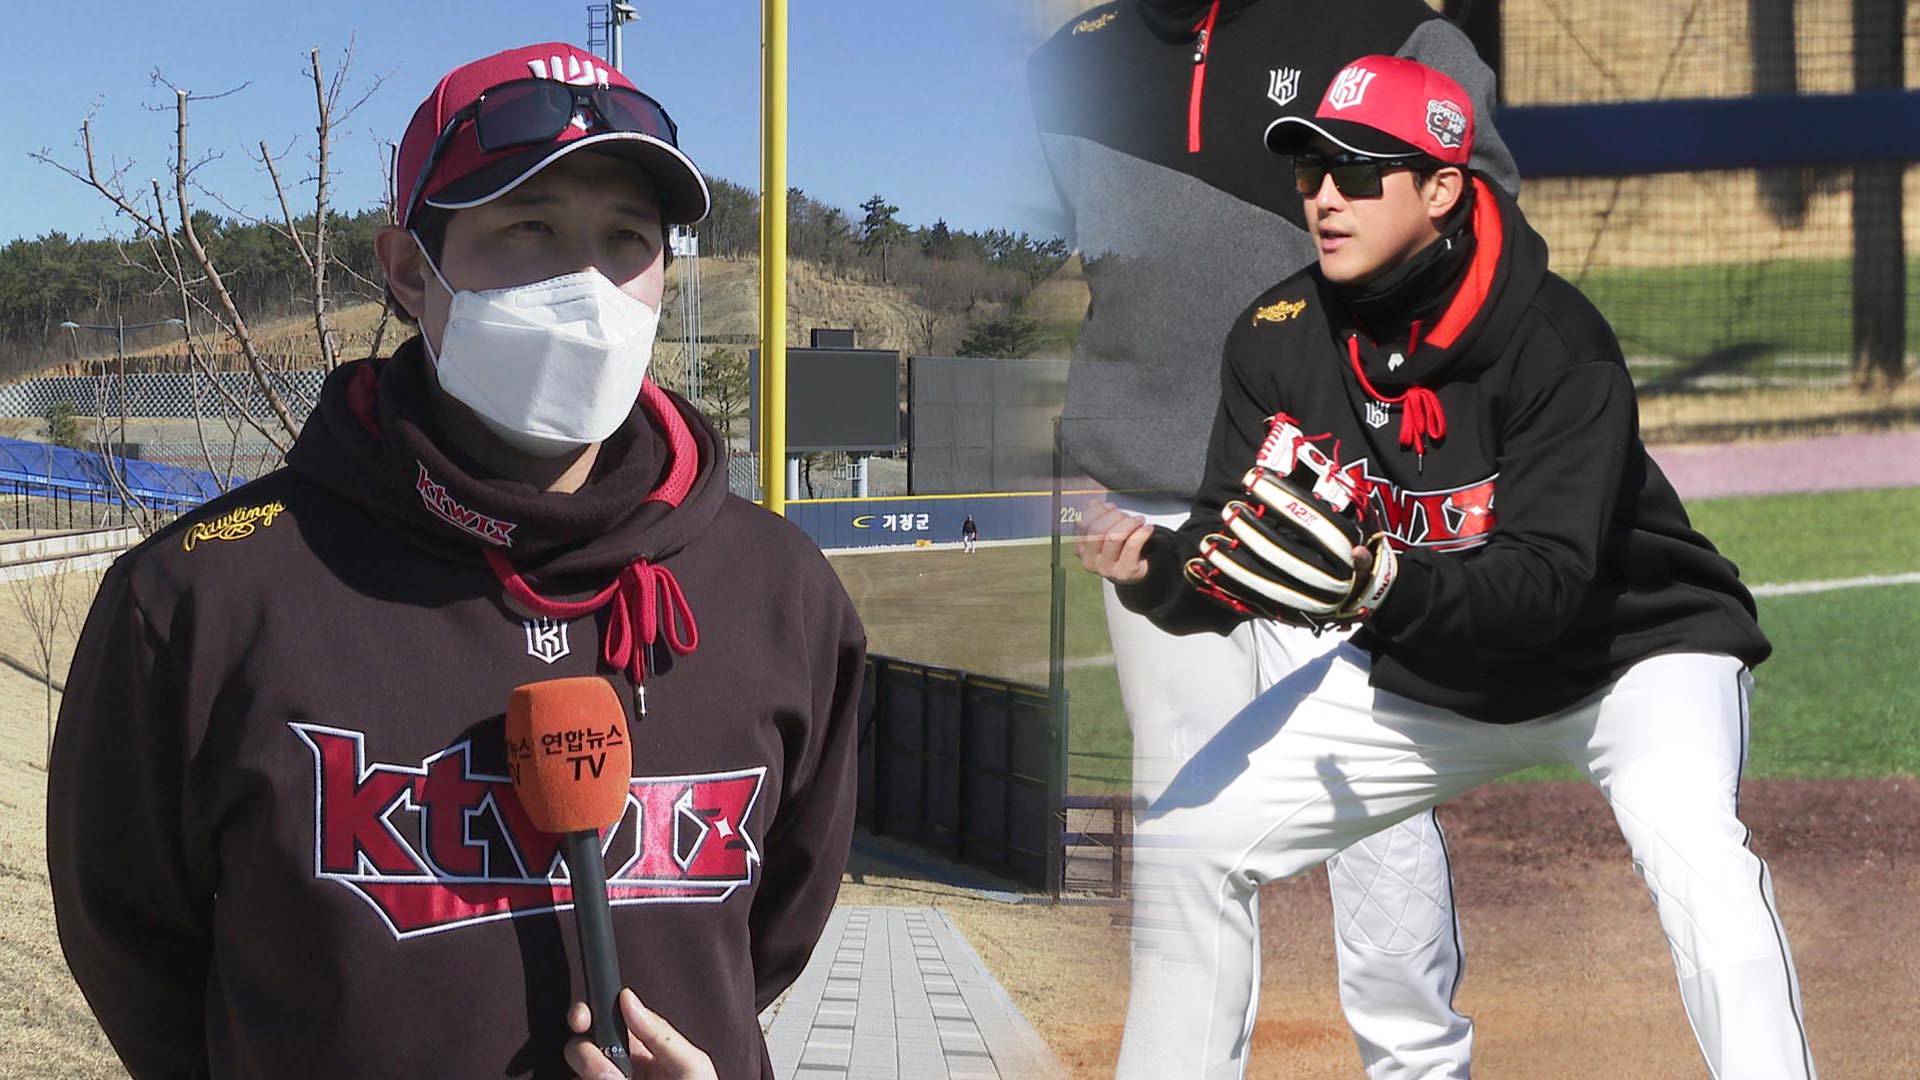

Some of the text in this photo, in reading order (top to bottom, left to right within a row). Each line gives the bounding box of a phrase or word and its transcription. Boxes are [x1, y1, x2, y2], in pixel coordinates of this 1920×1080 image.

[182, 500, 287, 552] Rawlings
[882, 512, 930, 532] 기장군
[541, 724, 624, 756] 연합뉴스
[566, 752, 607, 781] TV
